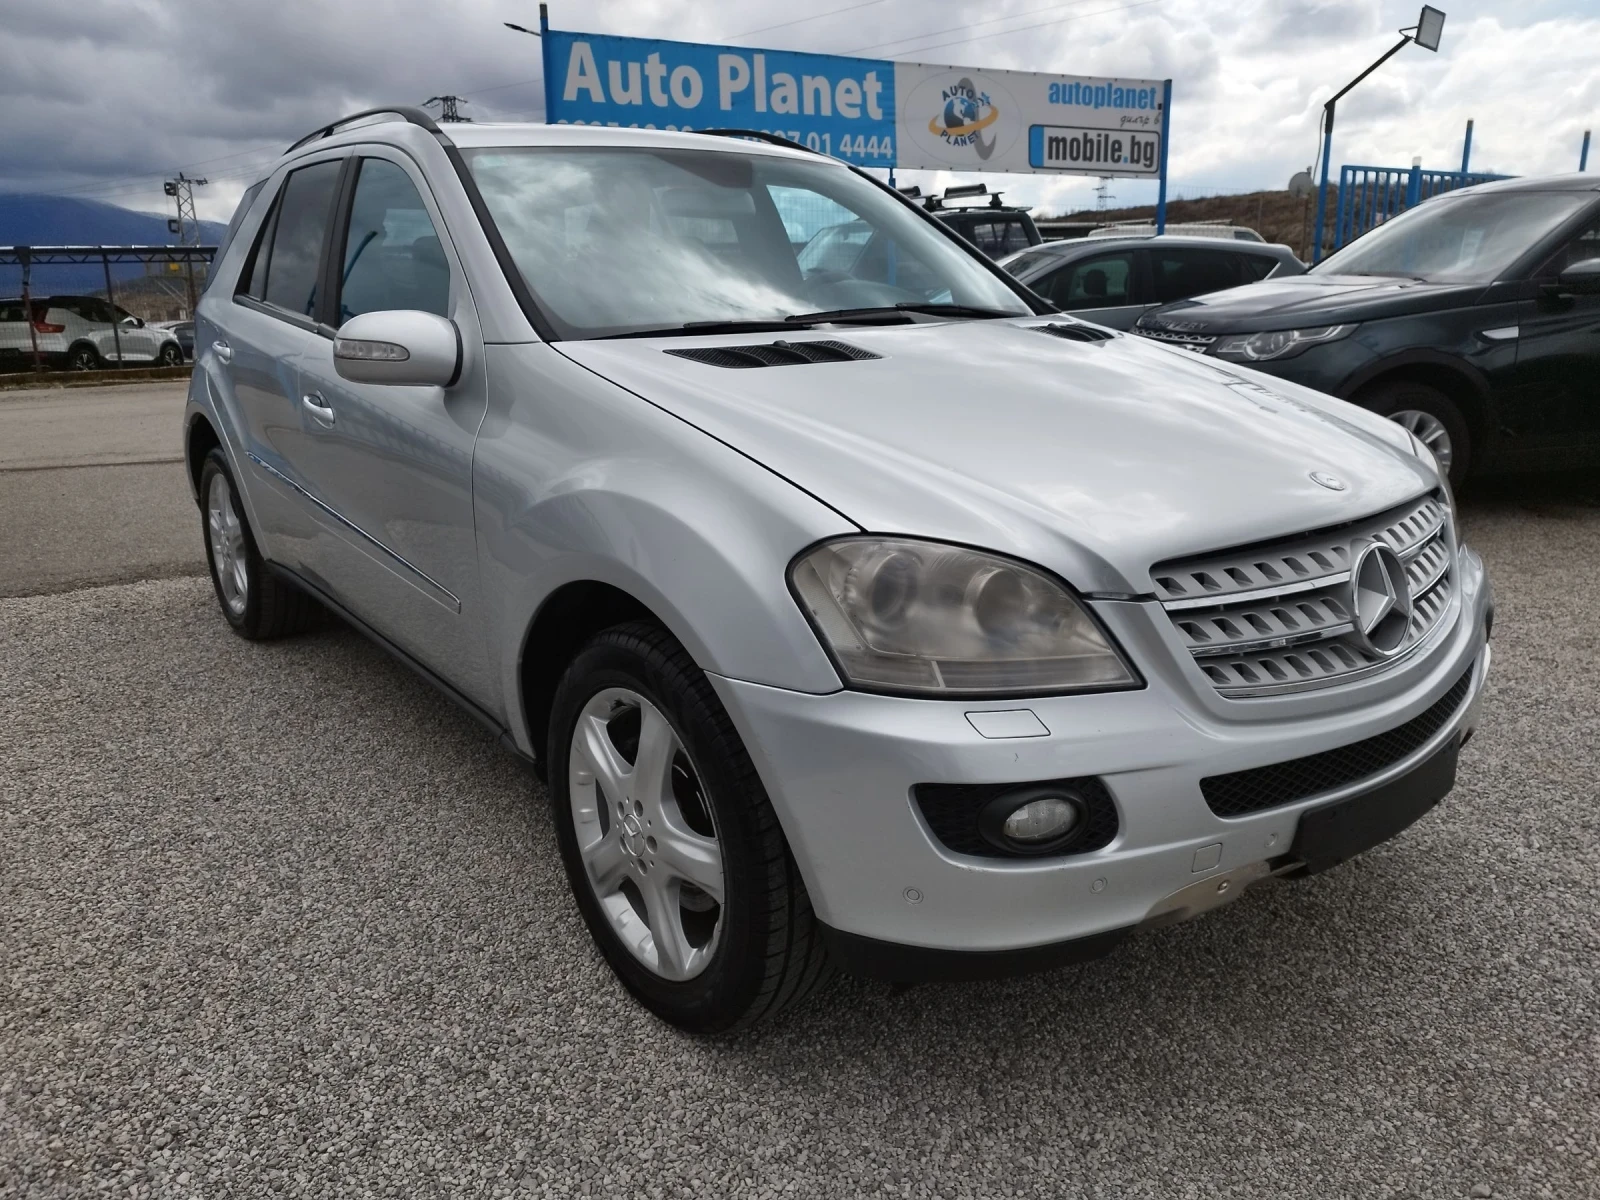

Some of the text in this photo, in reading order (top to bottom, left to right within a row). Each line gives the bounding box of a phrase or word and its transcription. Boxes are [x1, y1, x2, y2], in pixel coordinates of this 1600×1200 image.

[563, 42, 883, 120] Auto Planet
[942, 85, 974, 102] AUTO
[806, 131, 832, 156] 01
[839, 134, 892, 159] 4444
[940, 129, 979, 147] PLANET
[1048, 132, 1155, 168] mobile.bg
[1142, 319, 1209, 331] OVERY
